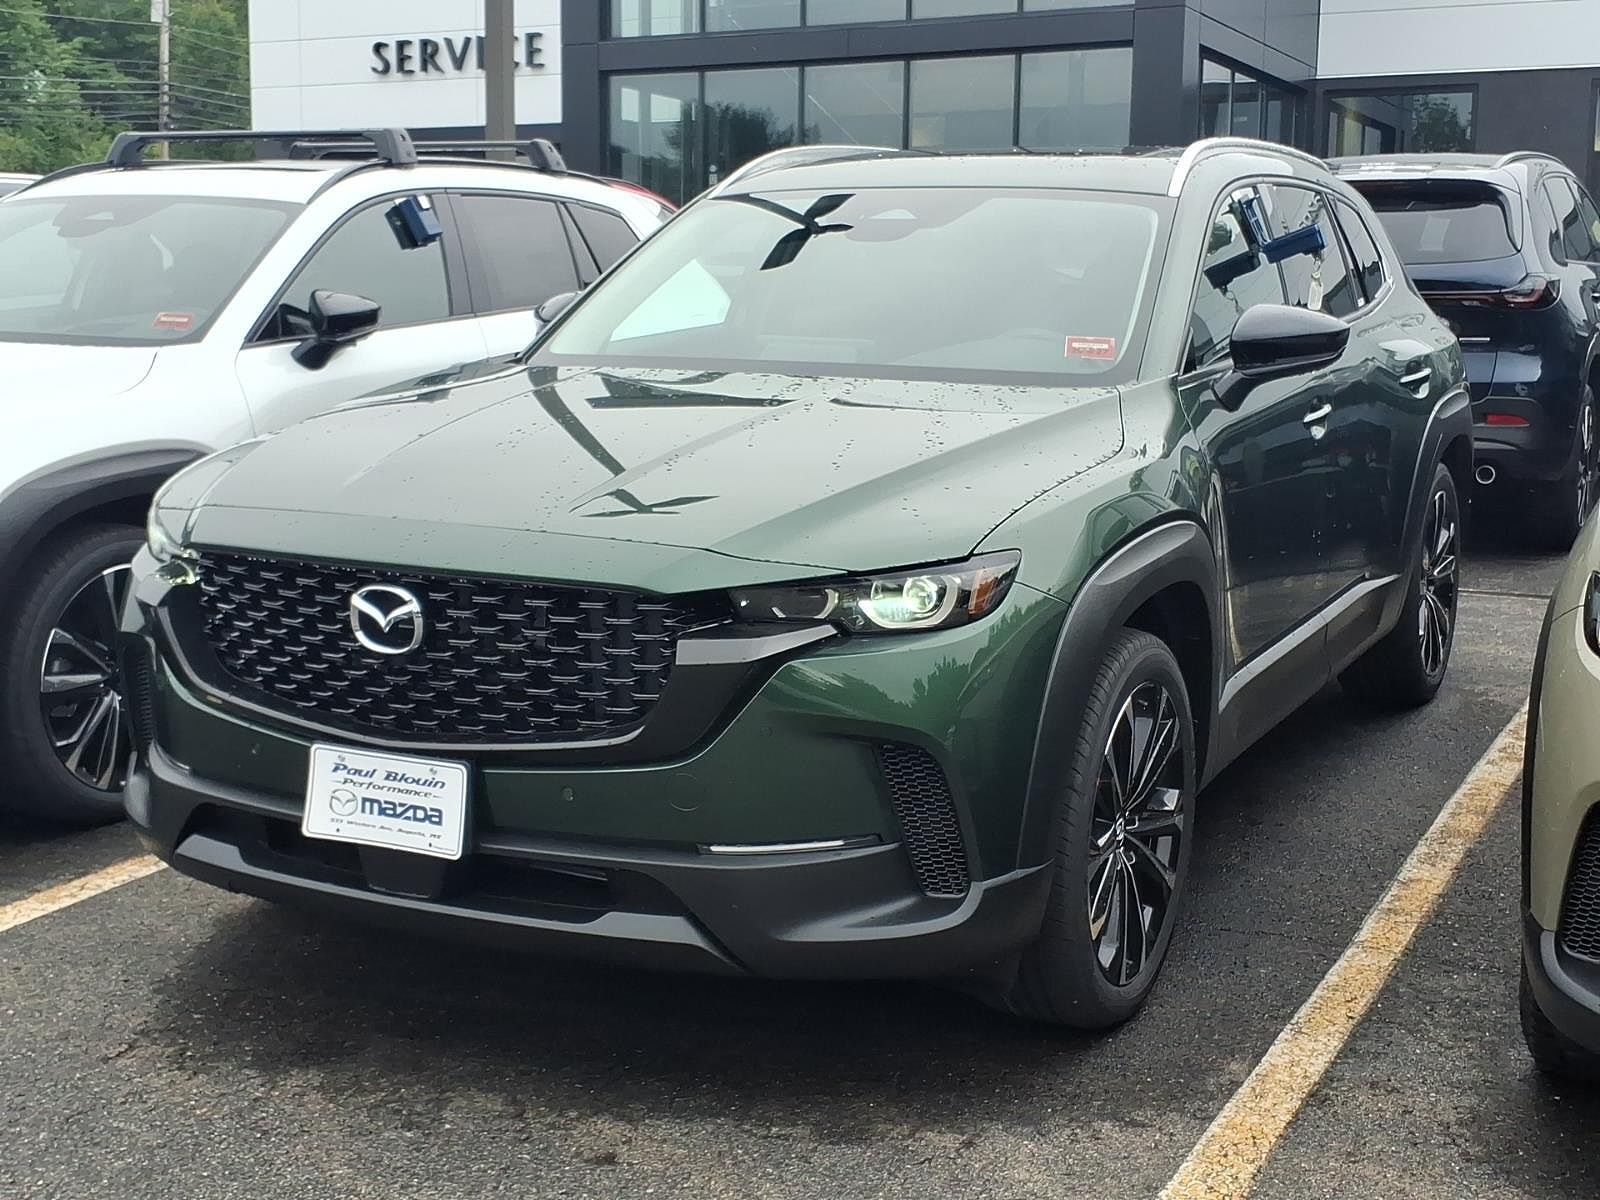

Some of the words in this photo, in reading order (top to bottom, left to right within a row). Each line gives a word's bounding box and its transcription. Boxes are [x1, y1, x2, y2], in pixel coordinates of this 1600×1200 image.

[370, 32, 545, 75] SERVIE
[331, 762, 377, 779] Paul
[383, 770, 446, 789] Blouin
[341, 777, 433, 798] Performance
